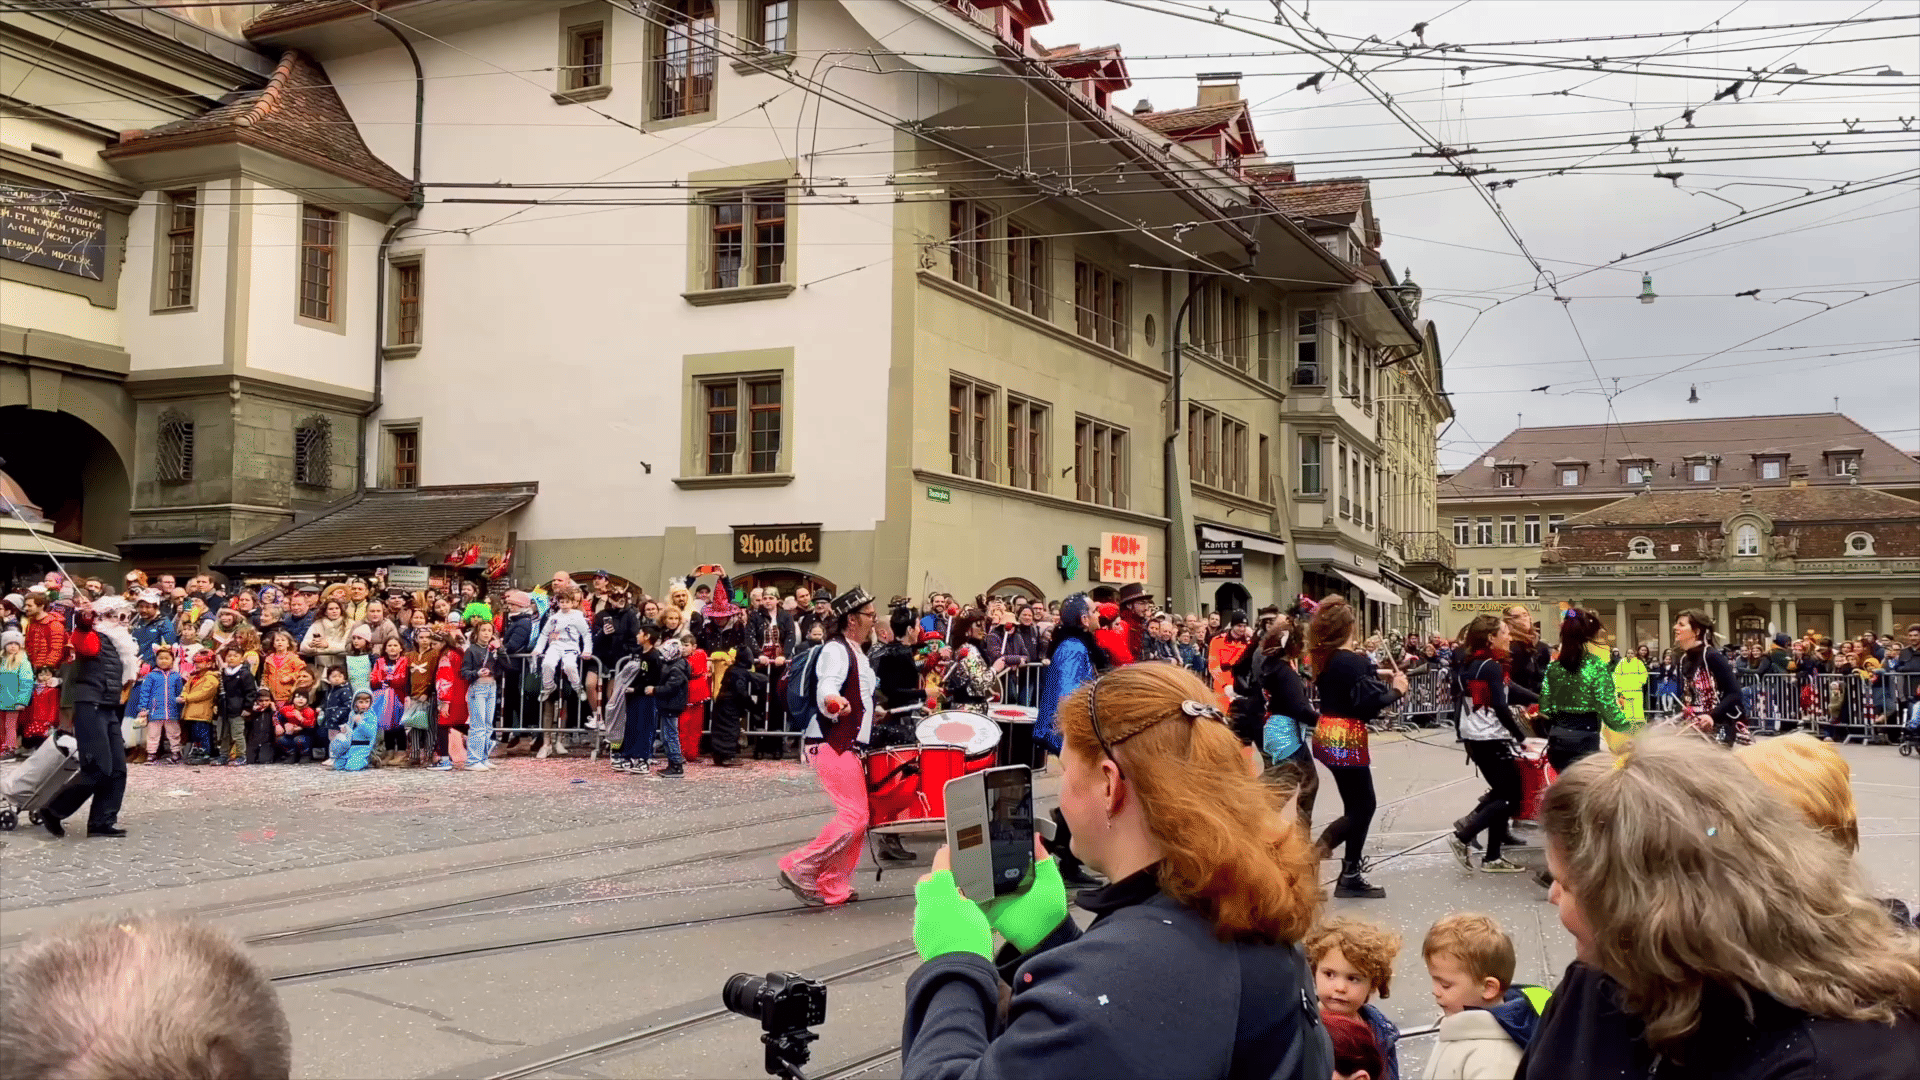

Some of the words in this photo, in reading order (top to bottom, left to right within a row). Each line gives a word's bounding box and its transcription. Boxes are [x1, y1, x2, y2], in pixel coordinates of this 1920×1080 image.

[740, 532, 813, 558] Apotheke
[1111, 535, 1140, 556] KON-
[1103, 558, 1145, 579] FETTI
[1451, 603, 1475, 611] FOTO
